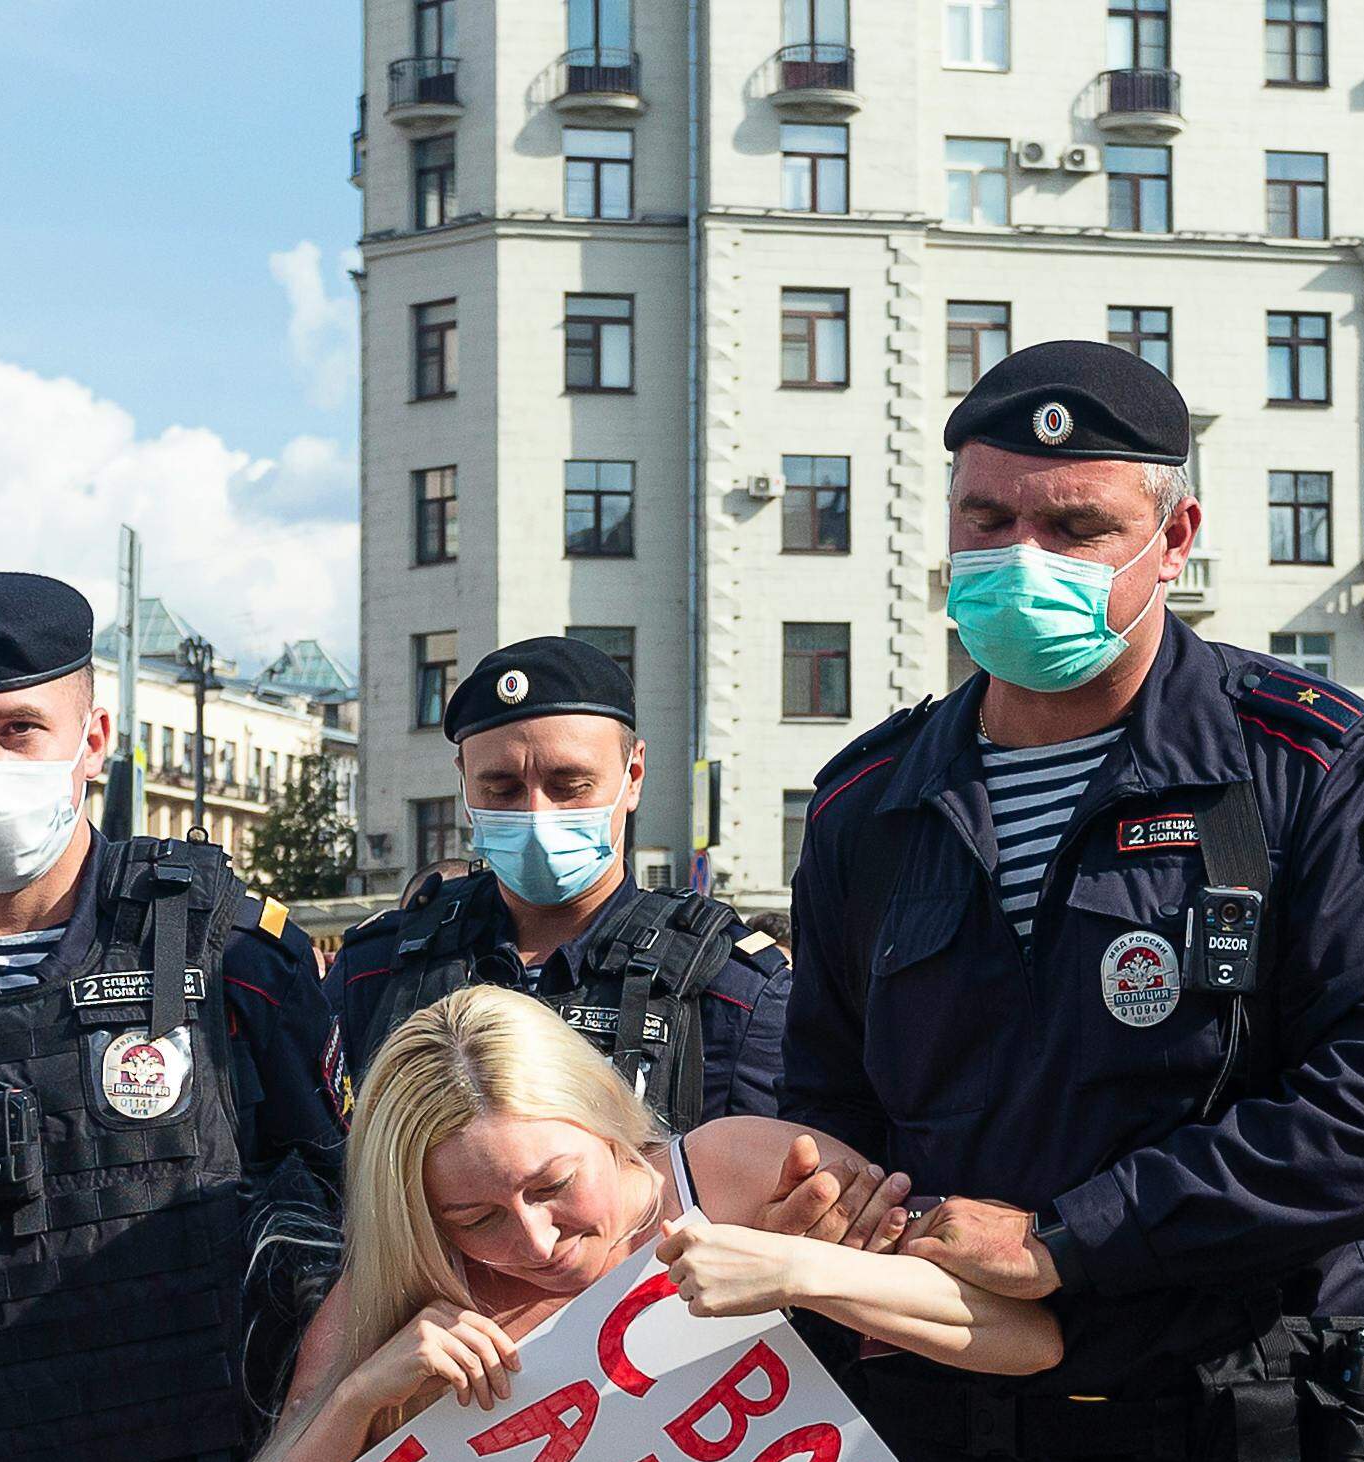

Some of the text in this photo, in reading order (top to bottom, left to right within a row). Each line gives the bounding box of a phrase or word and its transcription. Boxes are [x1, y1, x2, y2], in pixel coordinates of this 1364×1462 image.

[1128, 819, 1197, 845] 2 СПЕЦИА
[1108, 936, 1169, 960] МВД РОССИИ
[1209, 936, 1248, 951] DOZOR
[83, 980, 100, 1000] 2
[1115, 990, 1169, 1004] ПОЛИЦИЯ
[567, 1009, 582, 1025] 2
[1121, 1003, 1166, 1016] 010940
[116, 1084, 170, 1097] ПОЛИЦИЯ
